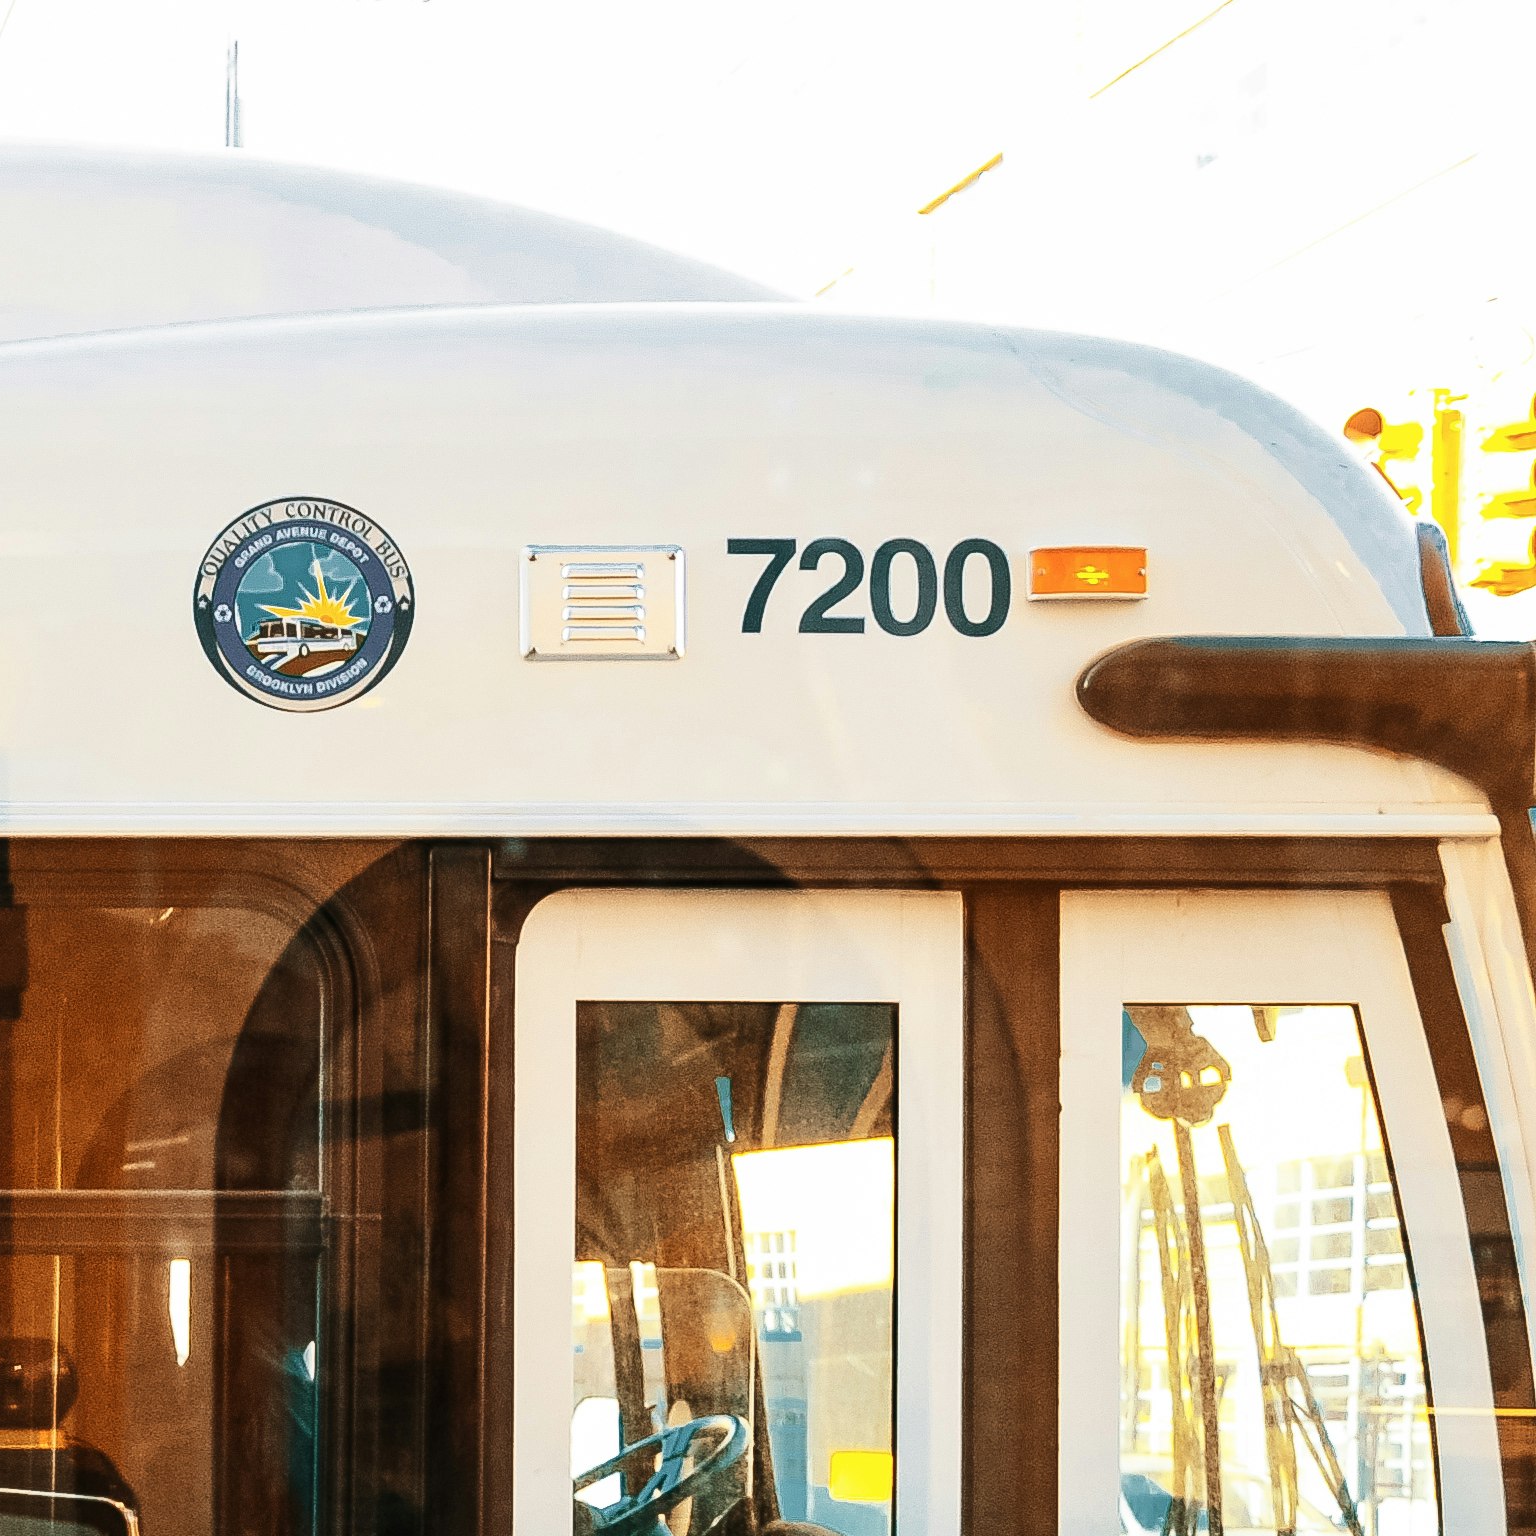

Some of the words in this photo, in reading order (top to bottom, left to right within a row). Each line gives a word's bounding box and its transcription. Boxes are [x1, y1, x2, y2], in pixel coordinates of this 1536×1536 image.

[202, 507, 274, 577] QUALITY
[284, 501, 373, 543] CONTROL
[374, 540, 408, 580] BUS
[233, 533, 274, 569] GRAND
[276, 525, 329, 542] AVENUE
[329, 533, 371, 565] DEPOT
[726, 536, 1013, 638] 7200
[245, 664, 315, 696] BROOKLYN
[315, 657, 369, 695] DIVISION
